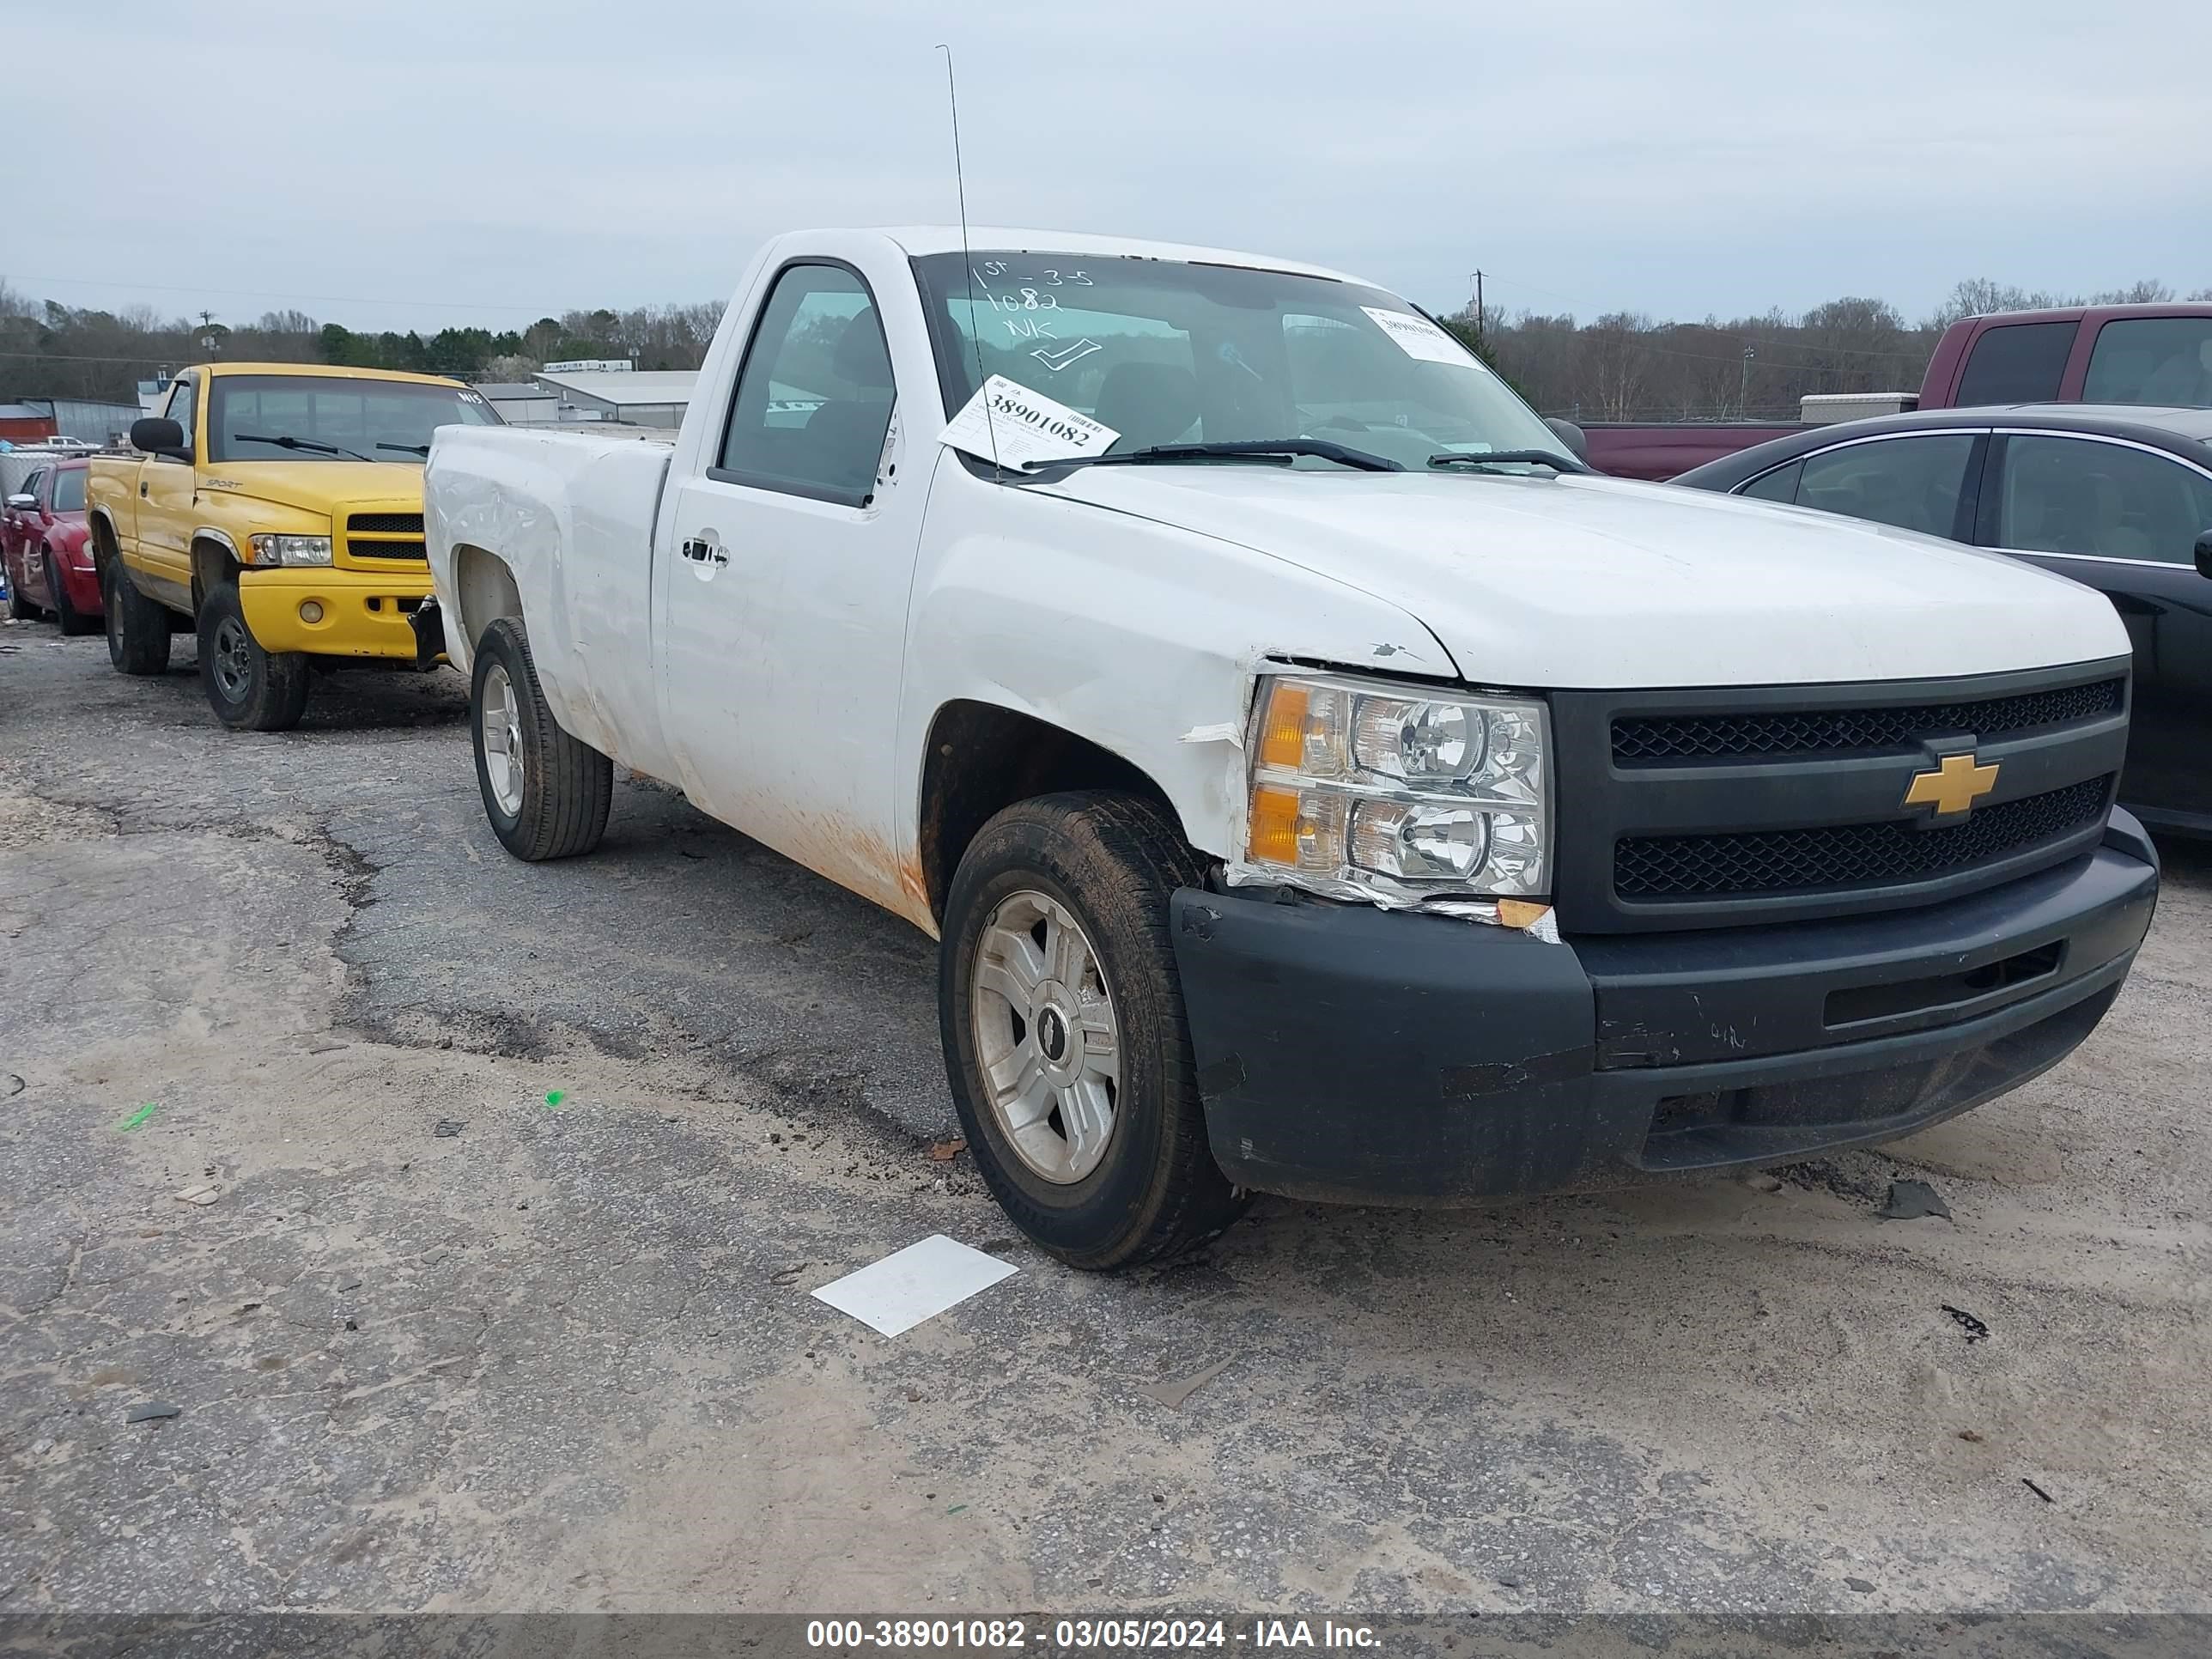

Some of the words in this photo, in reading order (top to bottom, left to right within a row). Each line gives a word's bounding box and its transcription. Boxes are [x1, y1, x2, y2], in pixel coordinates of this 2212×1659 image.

[986, 288, 1064, 313] 1082
[988, 393, 1091, 447] 38901082
[206, 479, 244, 489] SPORT
